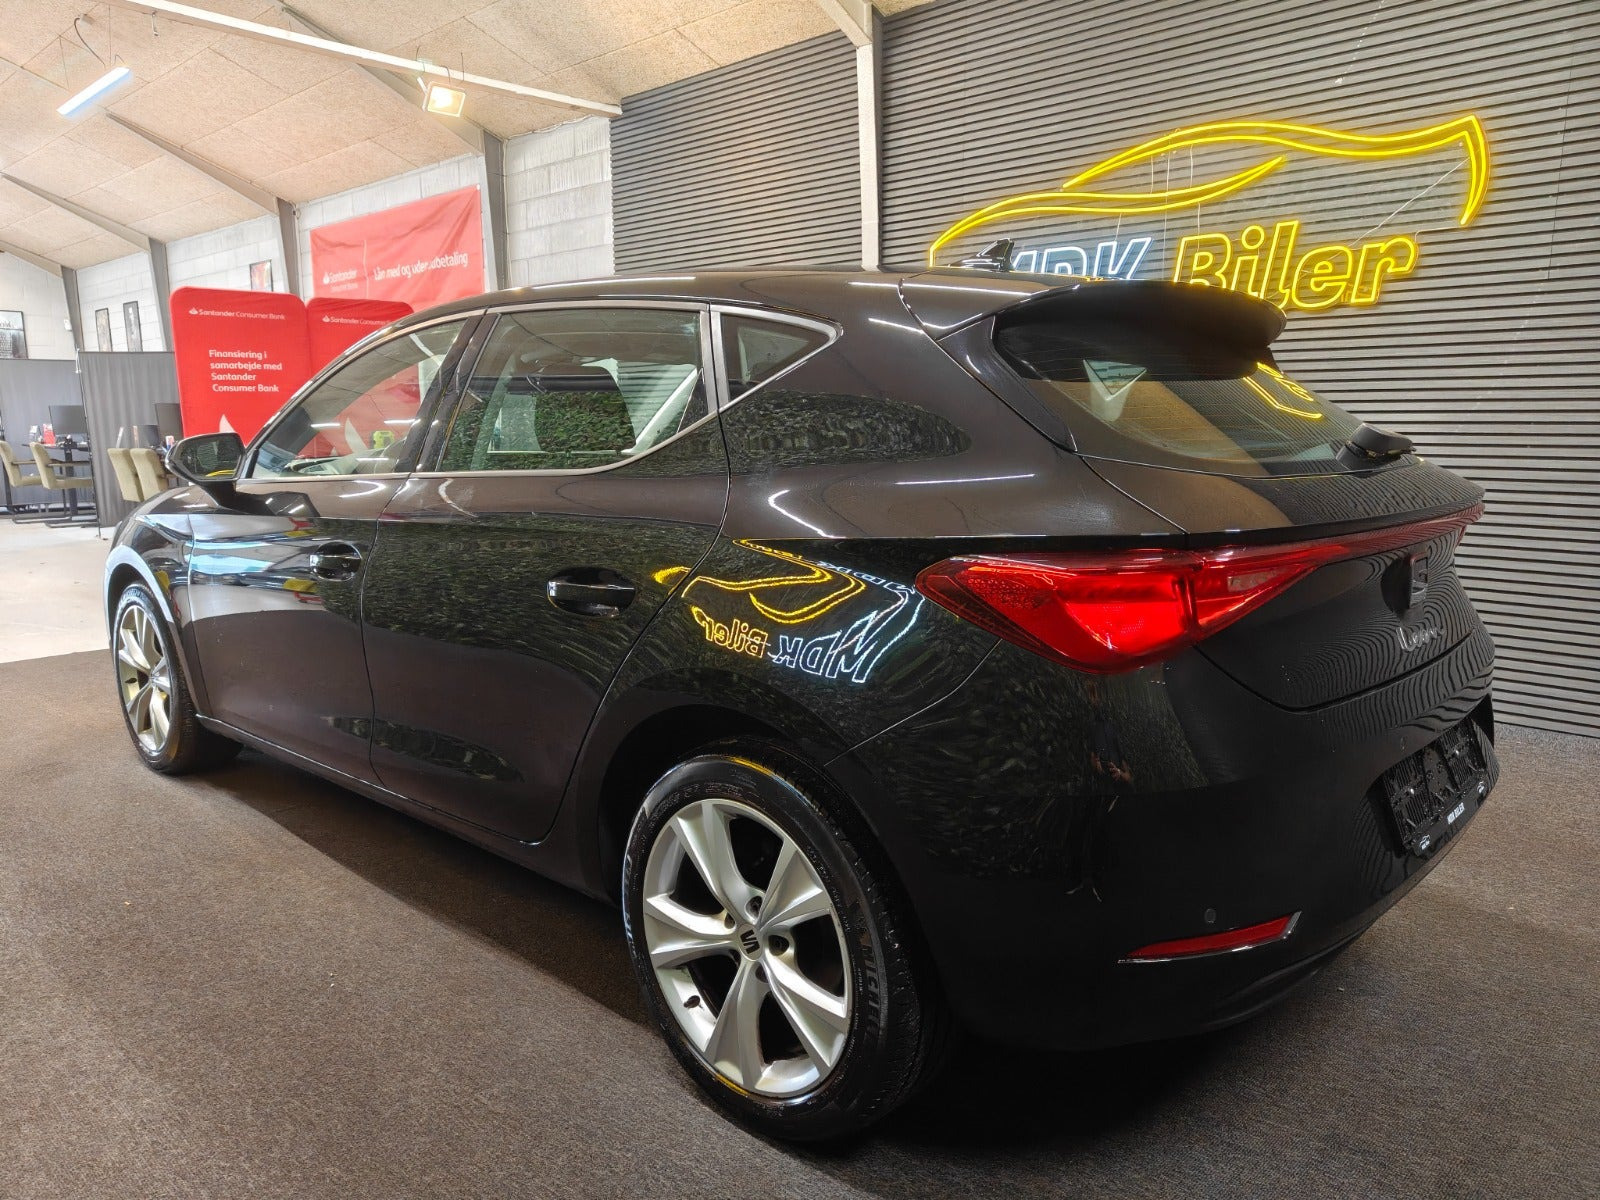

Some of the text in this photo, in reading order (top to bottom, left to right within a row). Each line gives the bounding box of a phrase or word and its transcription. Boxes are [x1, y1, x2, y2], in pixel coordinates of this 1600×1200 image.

[1009, 220, 1418, 309] DK Biler
[329, 268, 357, 283] Santander
[401, 264, 411, 278] og
[199, 308, 235, 317] Santander
[236, 311, 268, 319] Consumer
[330, 316, 359, 324] Santander
[209, 349, 262, 360] Finansiering
[210, 362, 282, 371] samarbejde med
[211, 372, 256, 380] Santander
[212, 383, 279, 392] Consumer Bank
